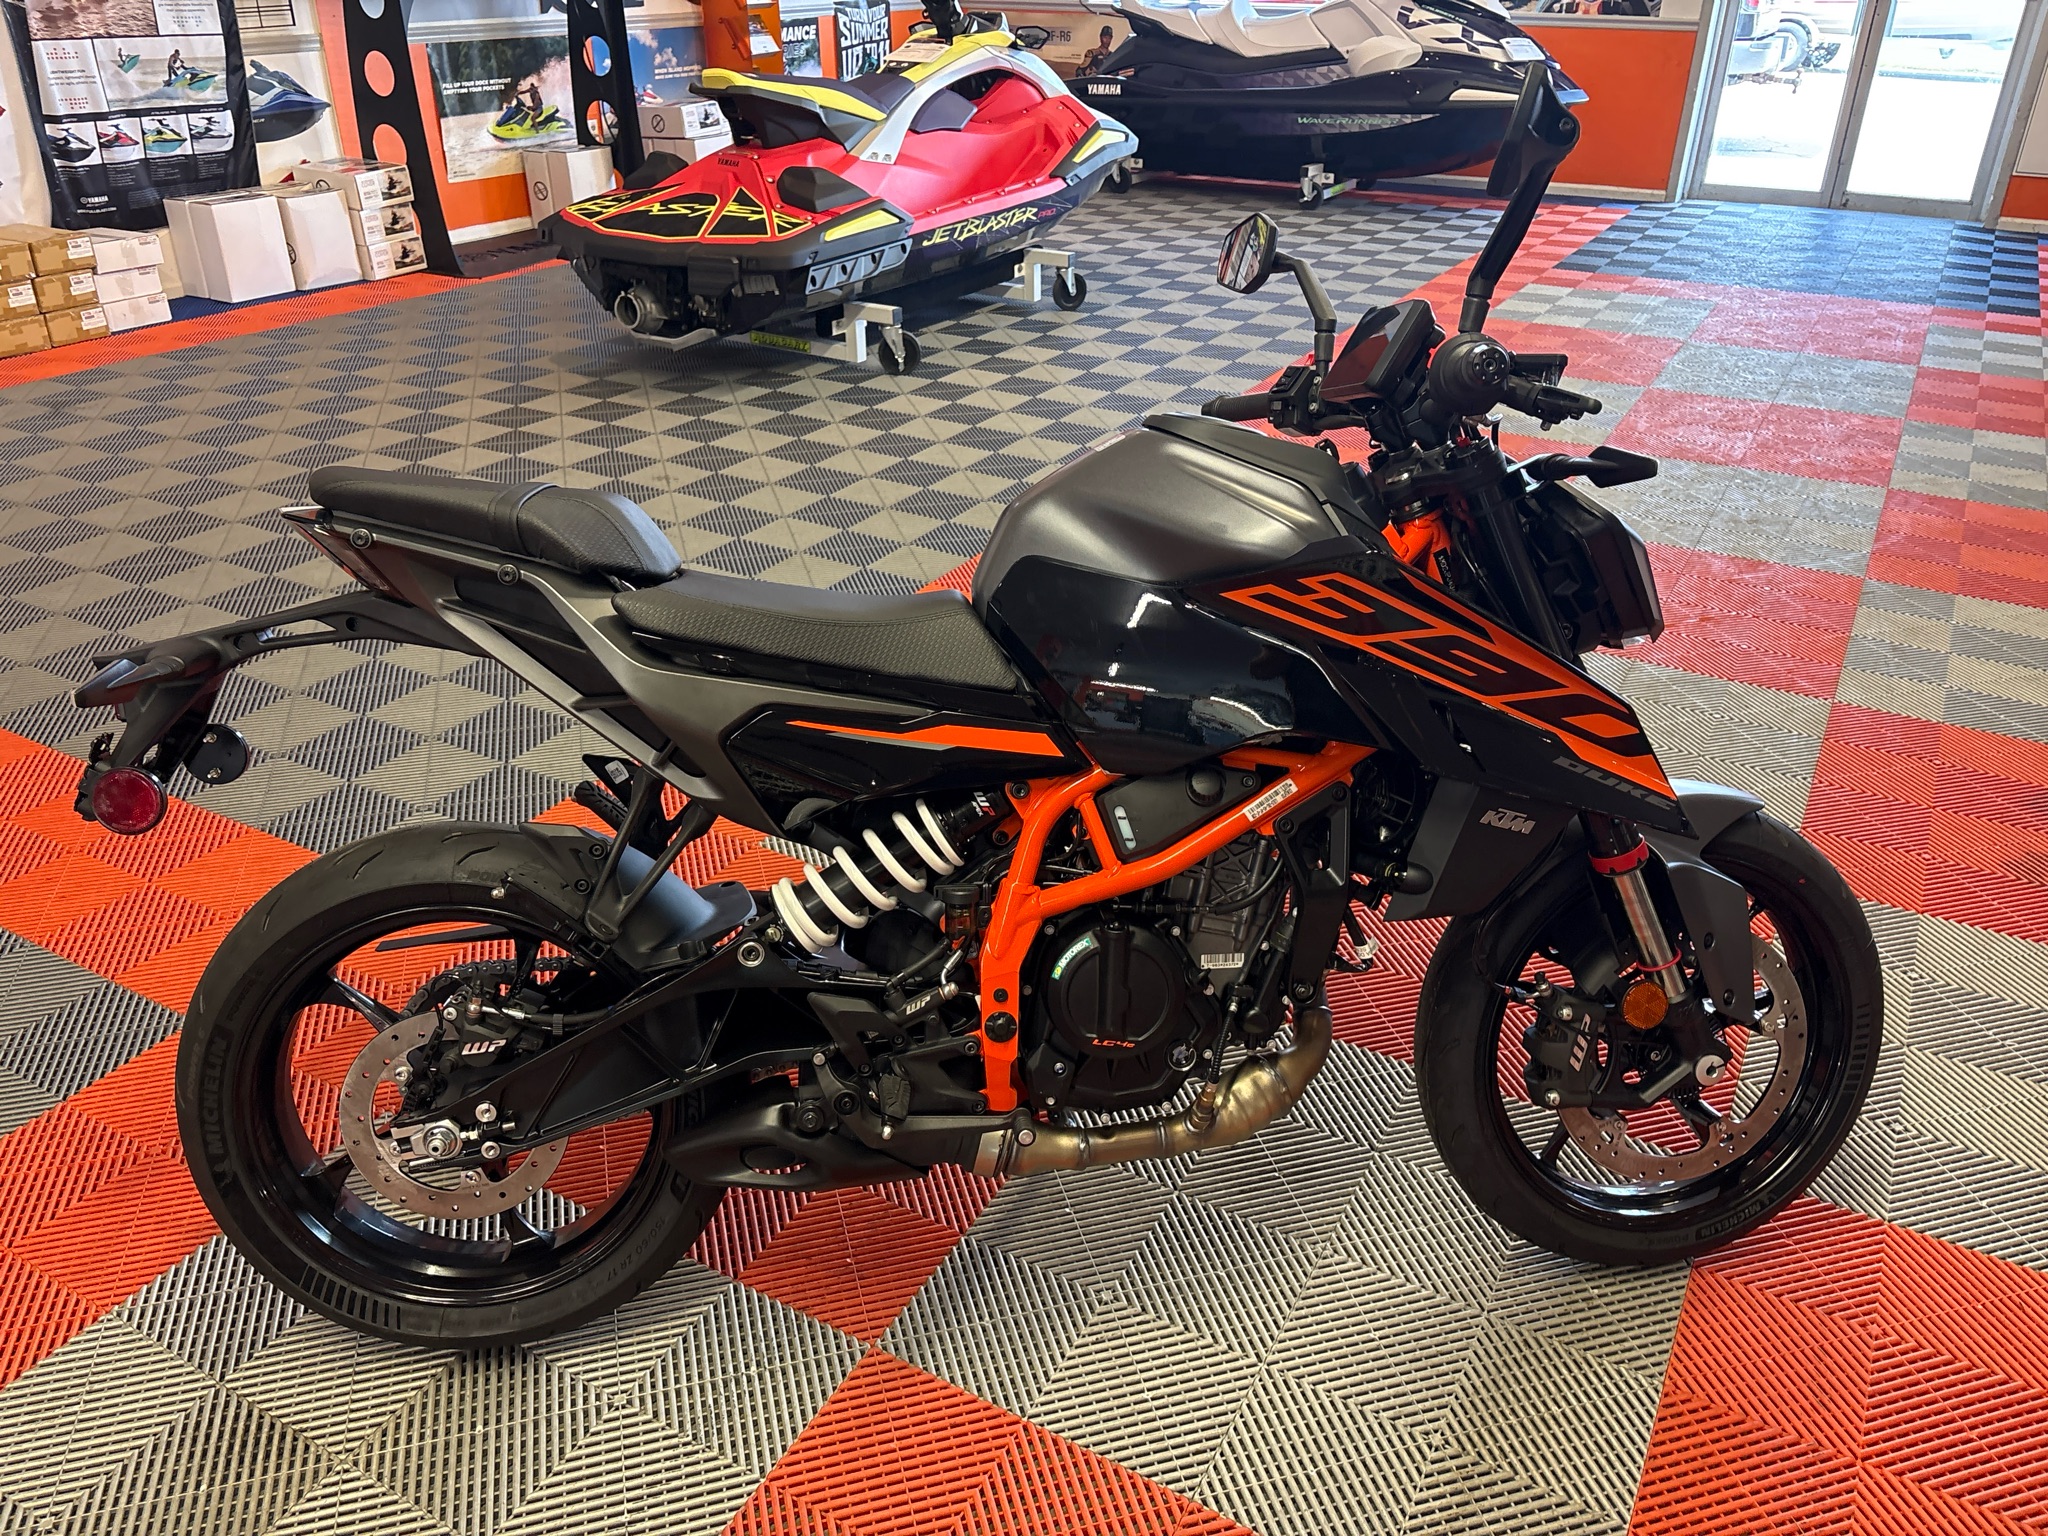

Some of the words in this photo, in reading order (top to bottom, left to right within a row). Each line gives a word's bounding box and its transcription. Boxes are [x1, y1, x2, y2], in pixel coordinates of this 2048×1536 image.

[845, 7, 868, 23] TURN
[868, 3, 886, 23] YOUR
[837, 12, 889, 48] SUMMER
[841, 45, 863, 80] UP
[442, 82, 453, 90] FILL
[489, 77, 512, 85] WITHOUT
[443, 88, 468, 96] EMPTYING
[483, 84, 505, 92] POCKETS
[1087, 83, 1121, 96] YAMAHA
[717, 157, 740, 169] YAMAHA
[922, 207, 1038, 247] JETBLASTER
[1552, 755, 1687, 812] DUKE
[973, 791, 996, 816] WP
[1479, 807, 1536, 835] KTM
[1057, 938, 1091, 970] MOTOREX
[905, 995, 931, 1016] WP
[461, 1039, 507, 1056] WP
[203, 1036, 227, 1156] MICHELIN
[1701, 1202, 1761, 1238] MICHELIN
